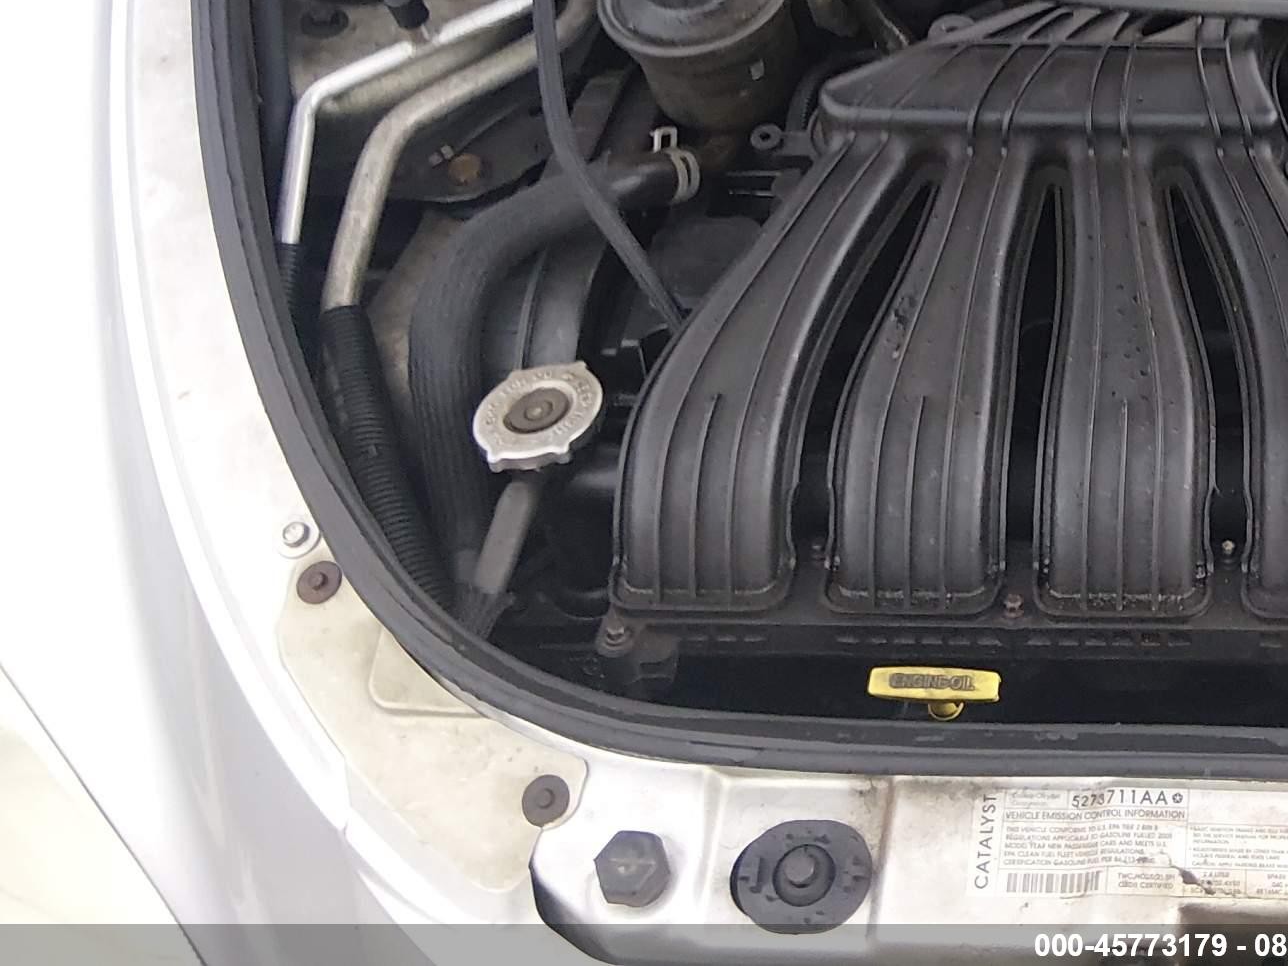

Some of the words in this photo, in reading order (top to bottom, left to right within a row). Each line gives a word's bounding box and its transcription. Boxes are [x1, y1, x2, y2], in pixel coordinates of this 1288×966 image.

[974, 793, 997, 890] CATALYST
[1005, 810, 1040, 821] VEHICLE
[1042, 810, 1082, 821] EMISSION
[1084, 808, 1121, 820] CONTROL
[1124, 808, 1185, 820] INFORMATION
